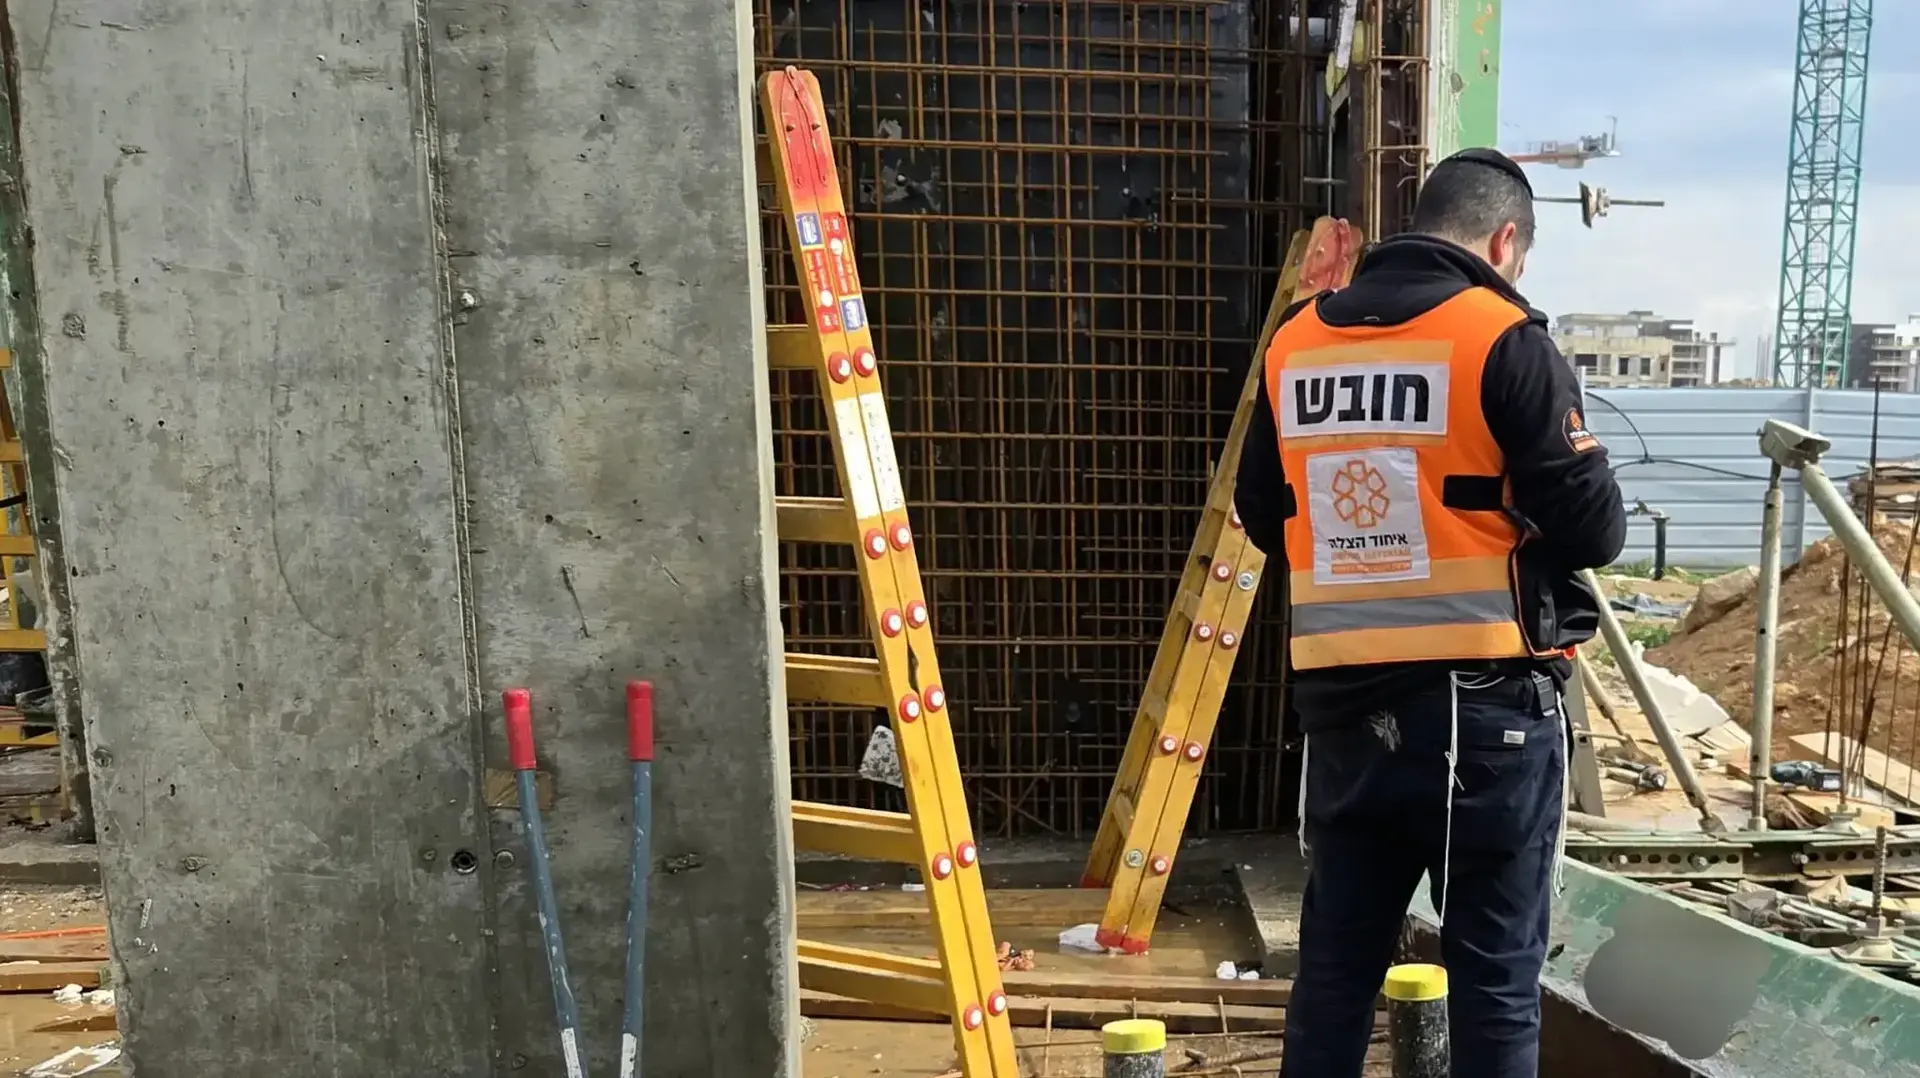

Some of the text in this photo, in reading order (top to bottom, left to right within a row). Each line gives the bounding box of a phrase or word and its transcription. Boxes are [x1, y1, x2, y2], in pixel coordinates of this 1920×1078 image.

[1295, 374, 1429, 425] חובש
[1328, 533, 1408, 549] איחוד הצלה
